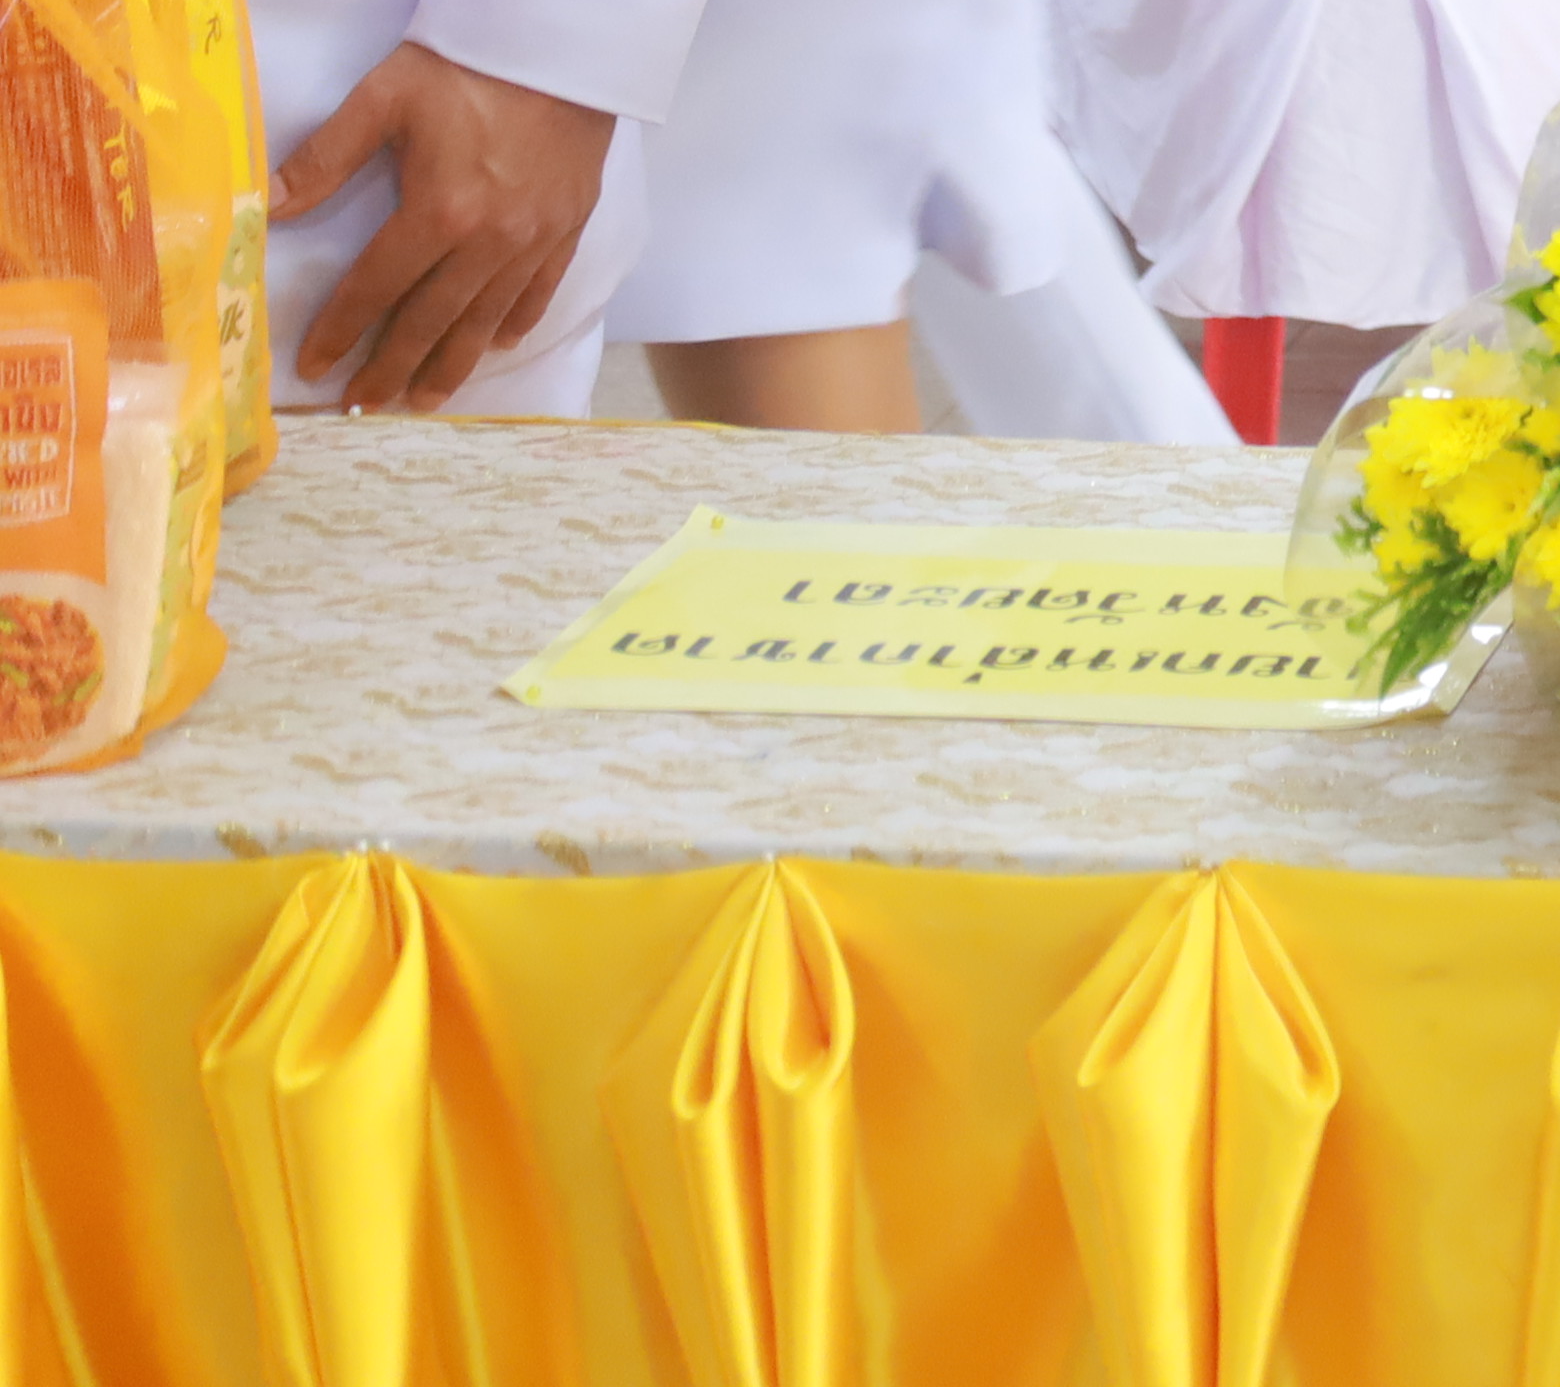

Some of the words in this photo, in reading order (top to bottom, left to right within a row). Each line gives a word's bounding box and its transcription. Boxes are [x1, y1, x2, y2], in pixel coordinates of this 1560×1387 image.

[783, 580, 1354, 631] จังหวัดยะลา
[611, 632, 1360, 683] ายกเหล่ากาชาด
